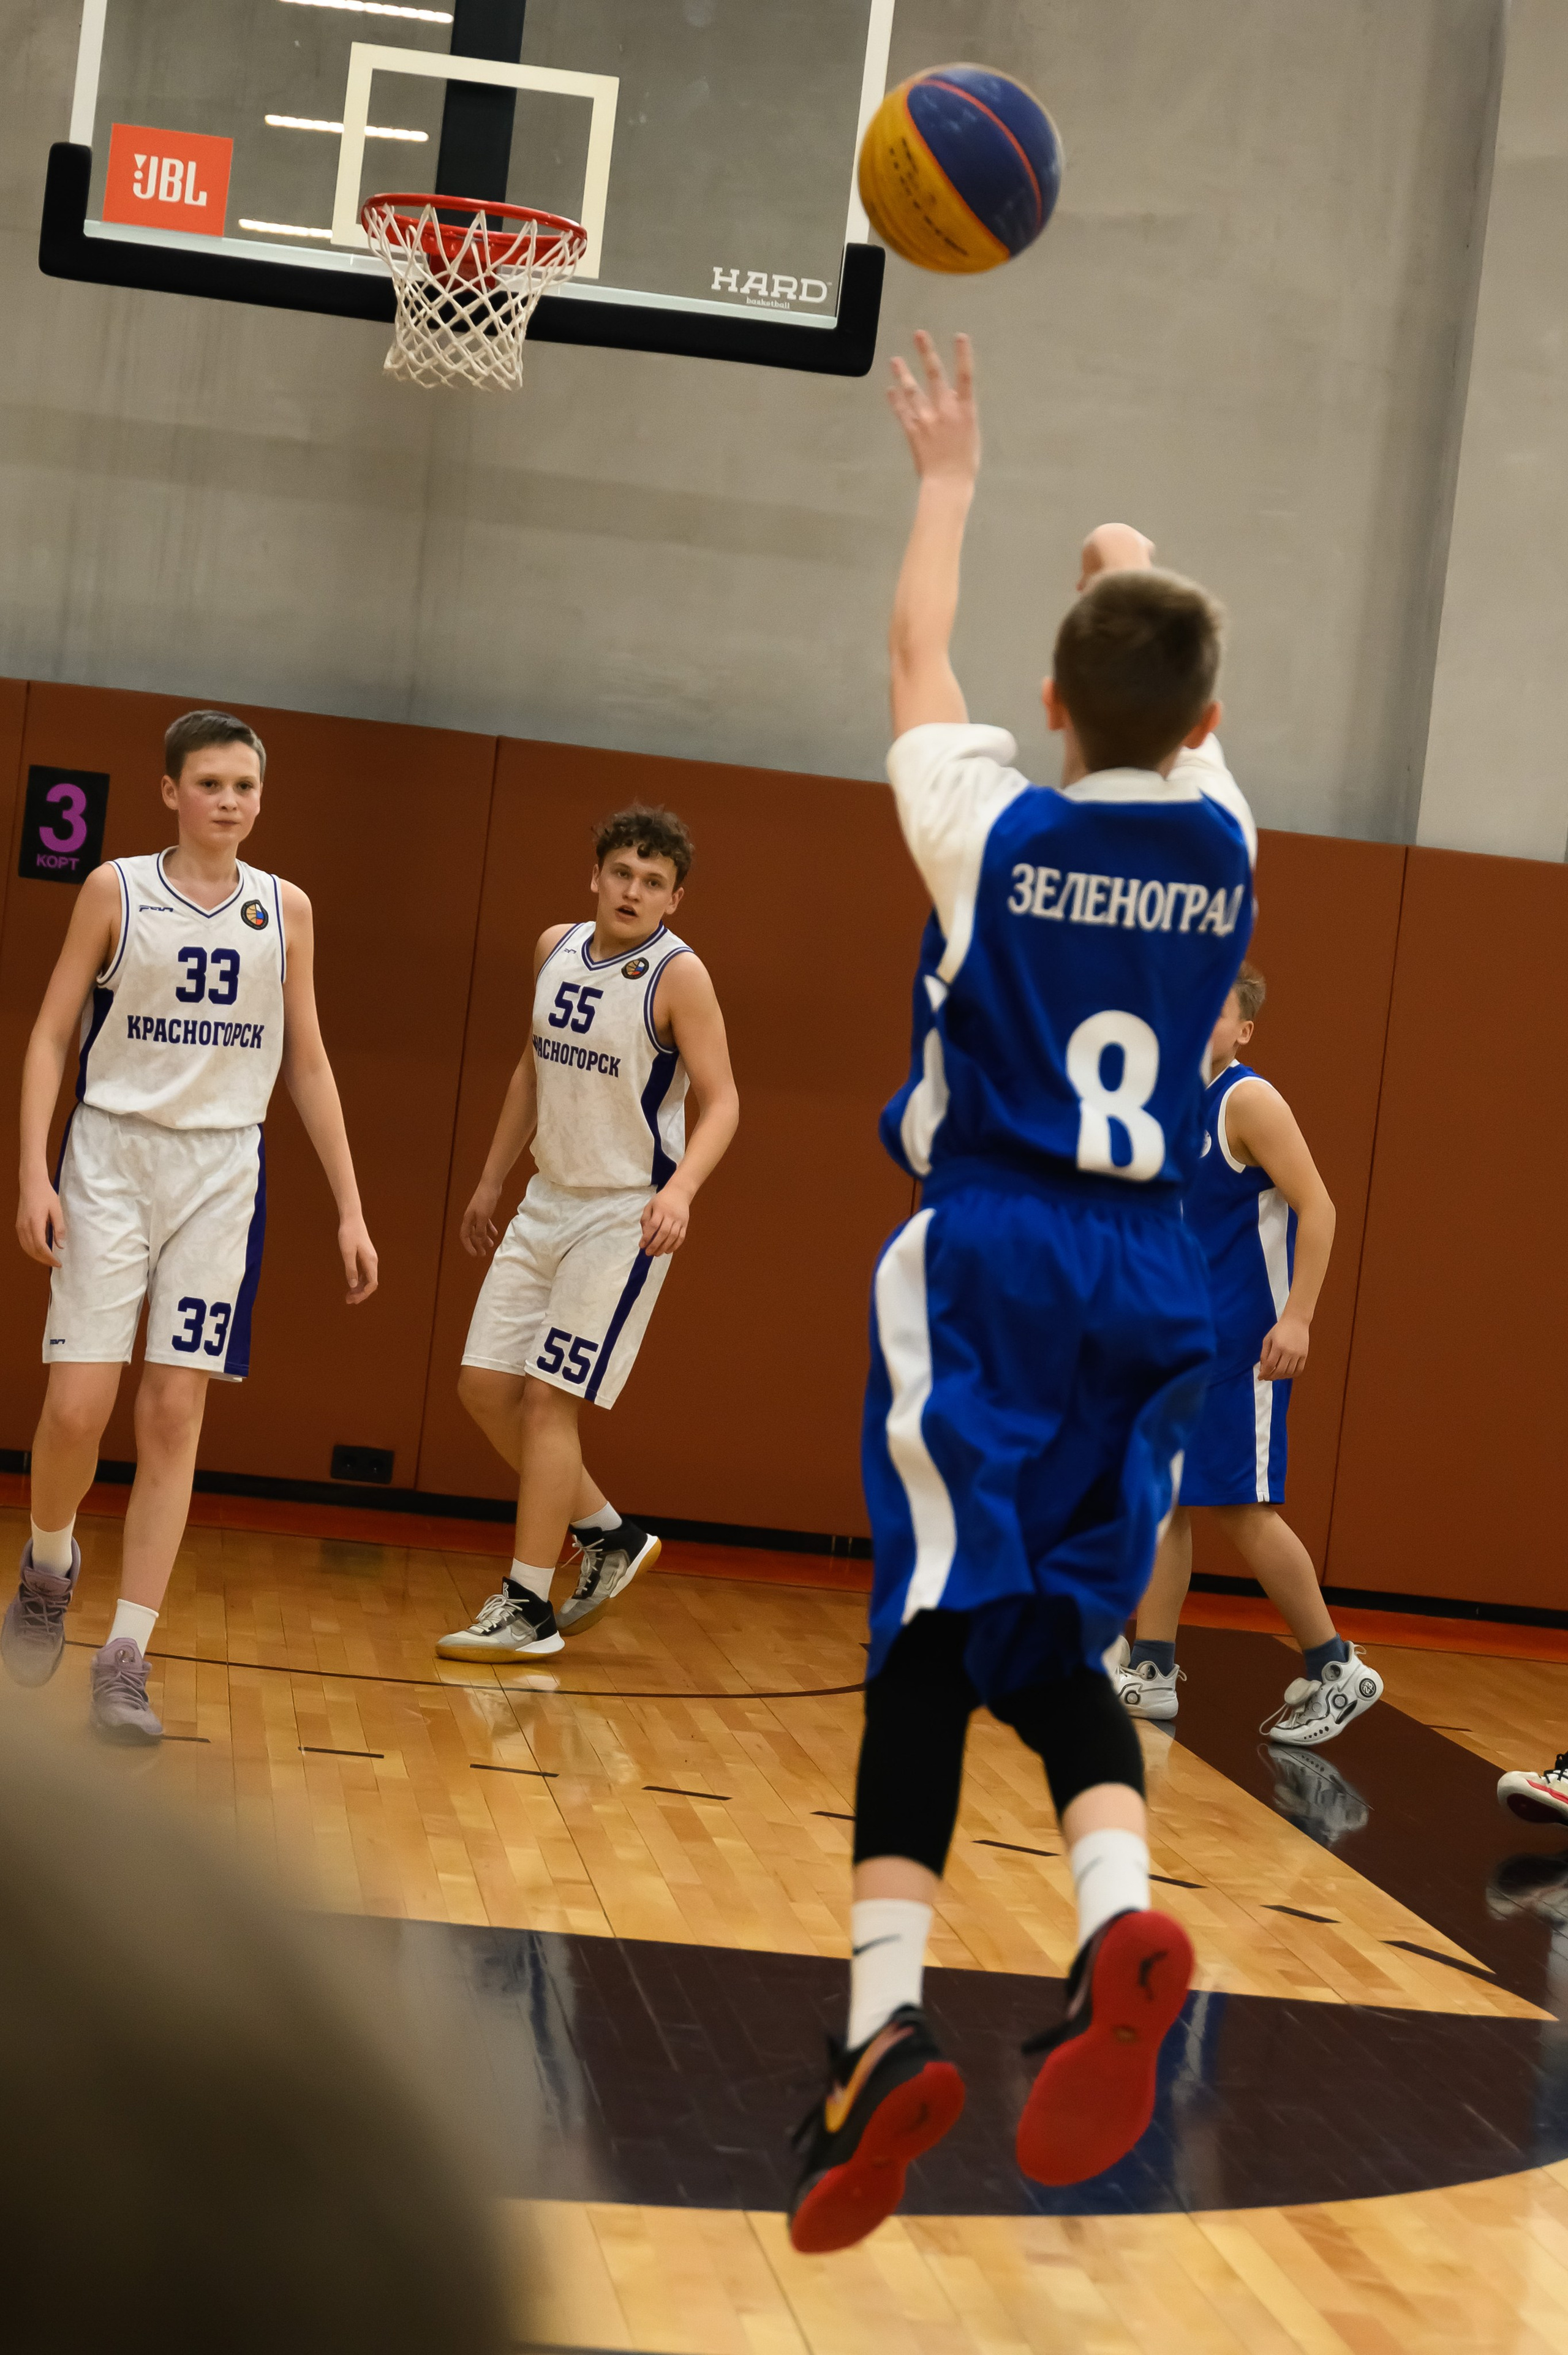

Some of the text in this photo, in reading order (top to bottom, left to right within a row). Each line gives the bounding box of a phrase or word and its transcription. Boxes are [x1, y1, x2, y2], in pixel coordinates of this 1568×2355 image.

[133, 153, 207, 206] JBL
[711, 266, 827, 303] HARD
[746, 297, 790, 309] basketball
[39, 783, 87, 853] 3
[36, 853, 80, 871] КОРТ
[175, 947, 241, 1005] 33
[127, 1015, 265, 1049] КРАСНОГОРСК
[548, 981, 604, 1034] 55
[532, 1034, 621, 1078] АСНОГОРСК
[1065, 1009, 1166, 1182] 8
[172, 1296, 232, 1356] 33
[537, 1326, 598, 1385] 55
